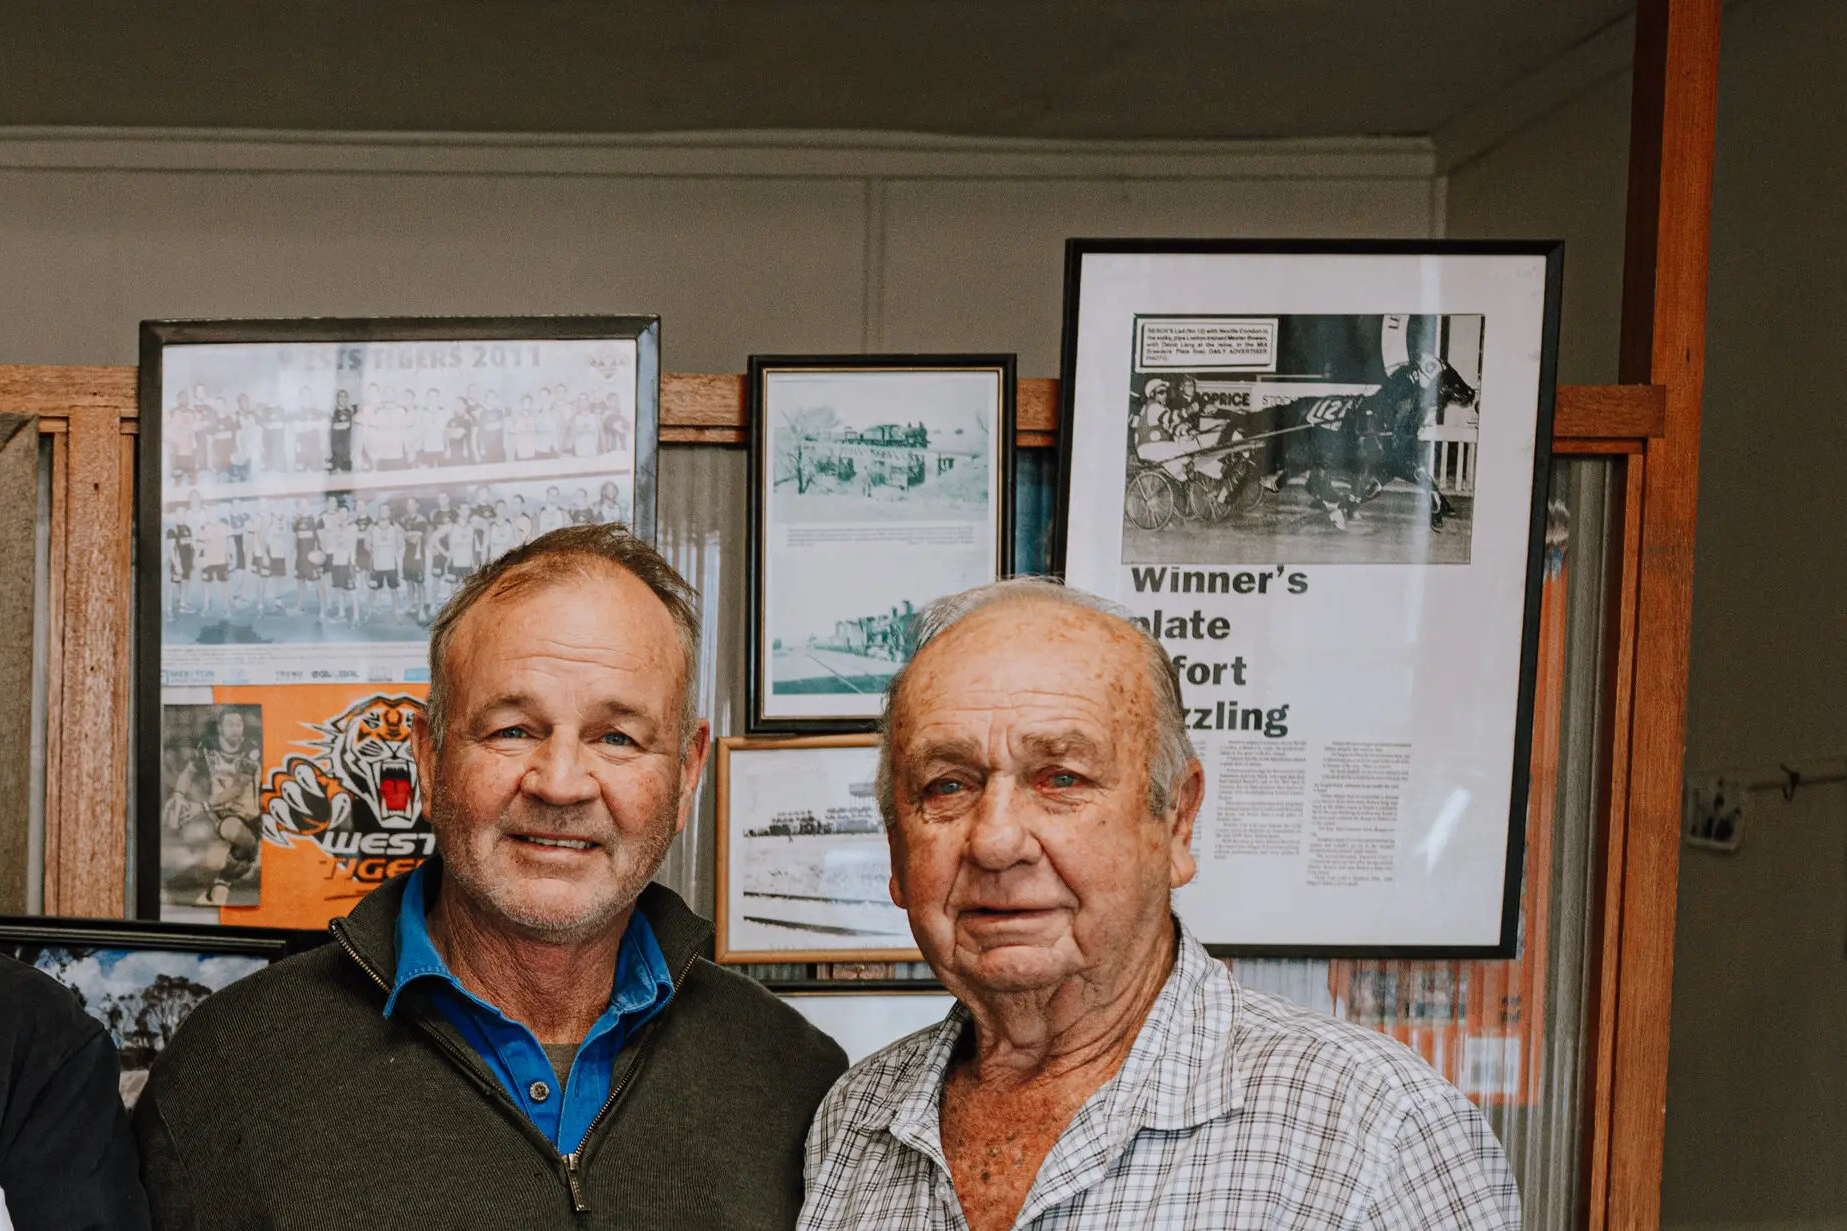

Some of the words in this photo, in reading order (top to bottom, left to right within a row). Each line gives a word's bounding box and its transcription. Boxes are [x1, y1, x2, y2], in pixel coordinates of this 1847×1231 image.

[371, 346, 463, 370] TIGERS
[471, 346, 542, 369] 2011
[1131, 564, 1309, 595] Winner's
